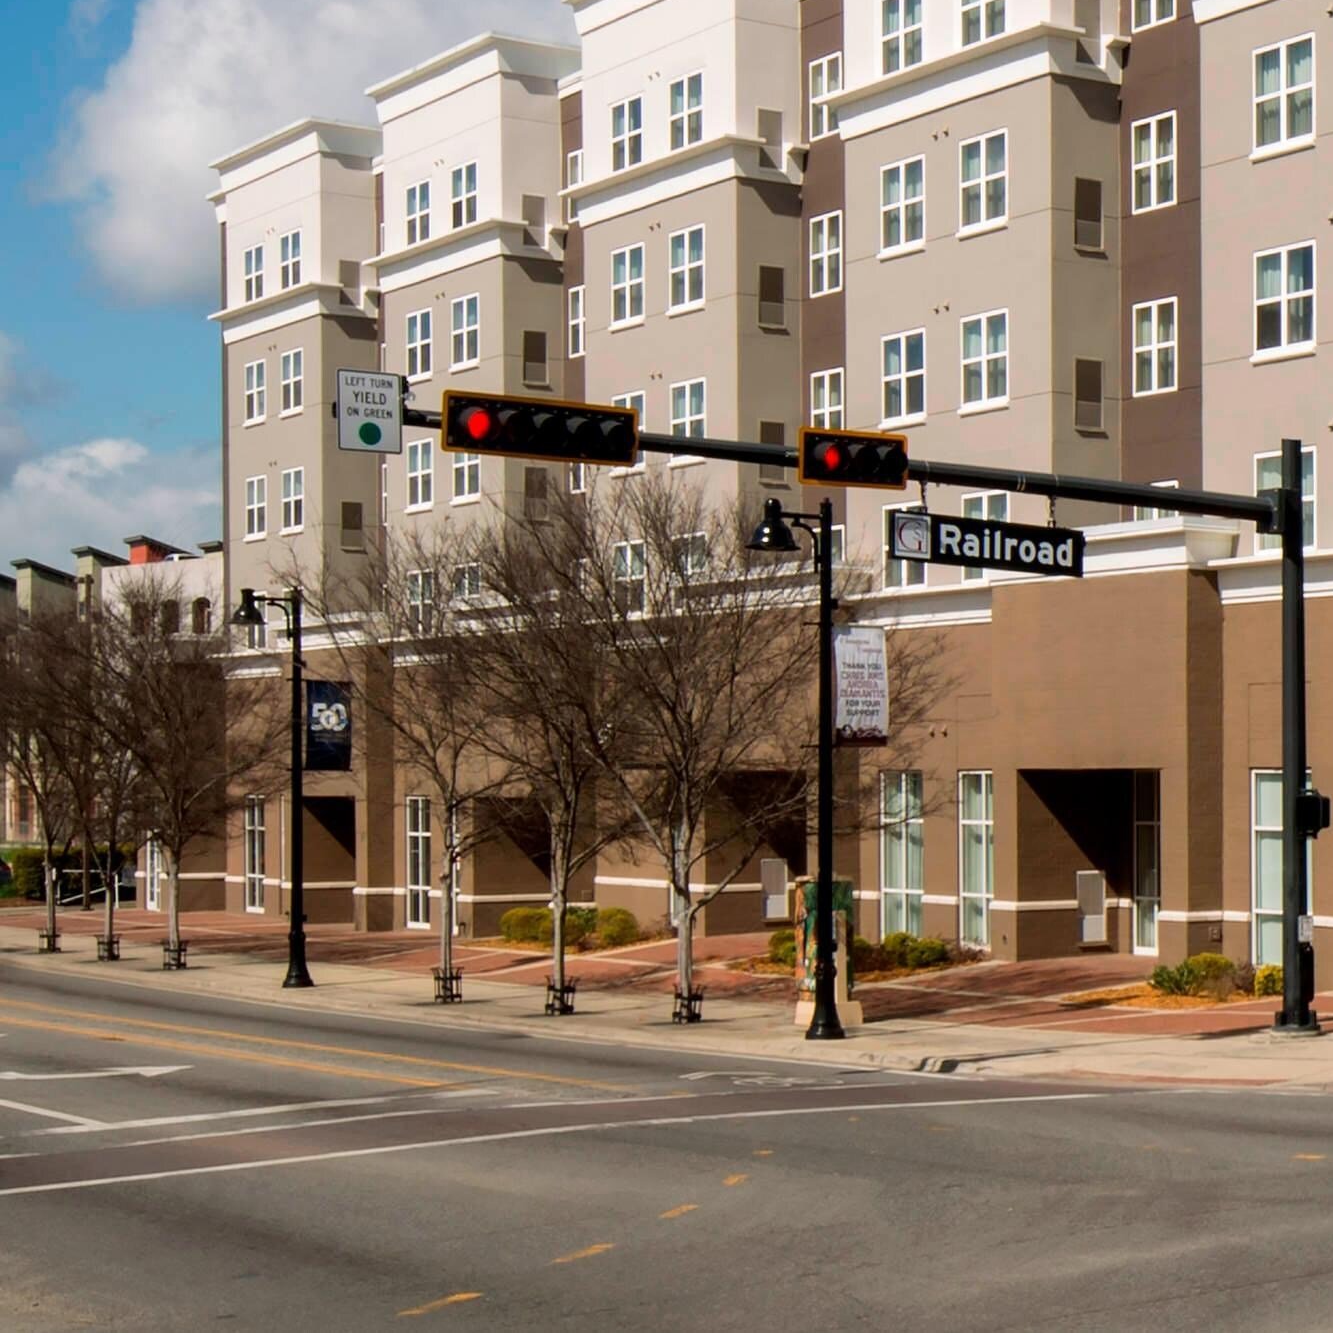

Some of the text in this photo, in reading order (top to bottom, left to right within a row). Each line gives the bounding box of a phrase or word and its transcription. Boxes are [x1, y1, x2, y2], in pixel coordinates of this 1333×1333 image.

[345, 376, 393, 389] LEFT TURN
[352, 390, 387, 406] YIELD
[346, 406, 393, 419] ON GREEN
[939, 523, 1073, 567] Railroad
[311, 702, 349, 732] 50
